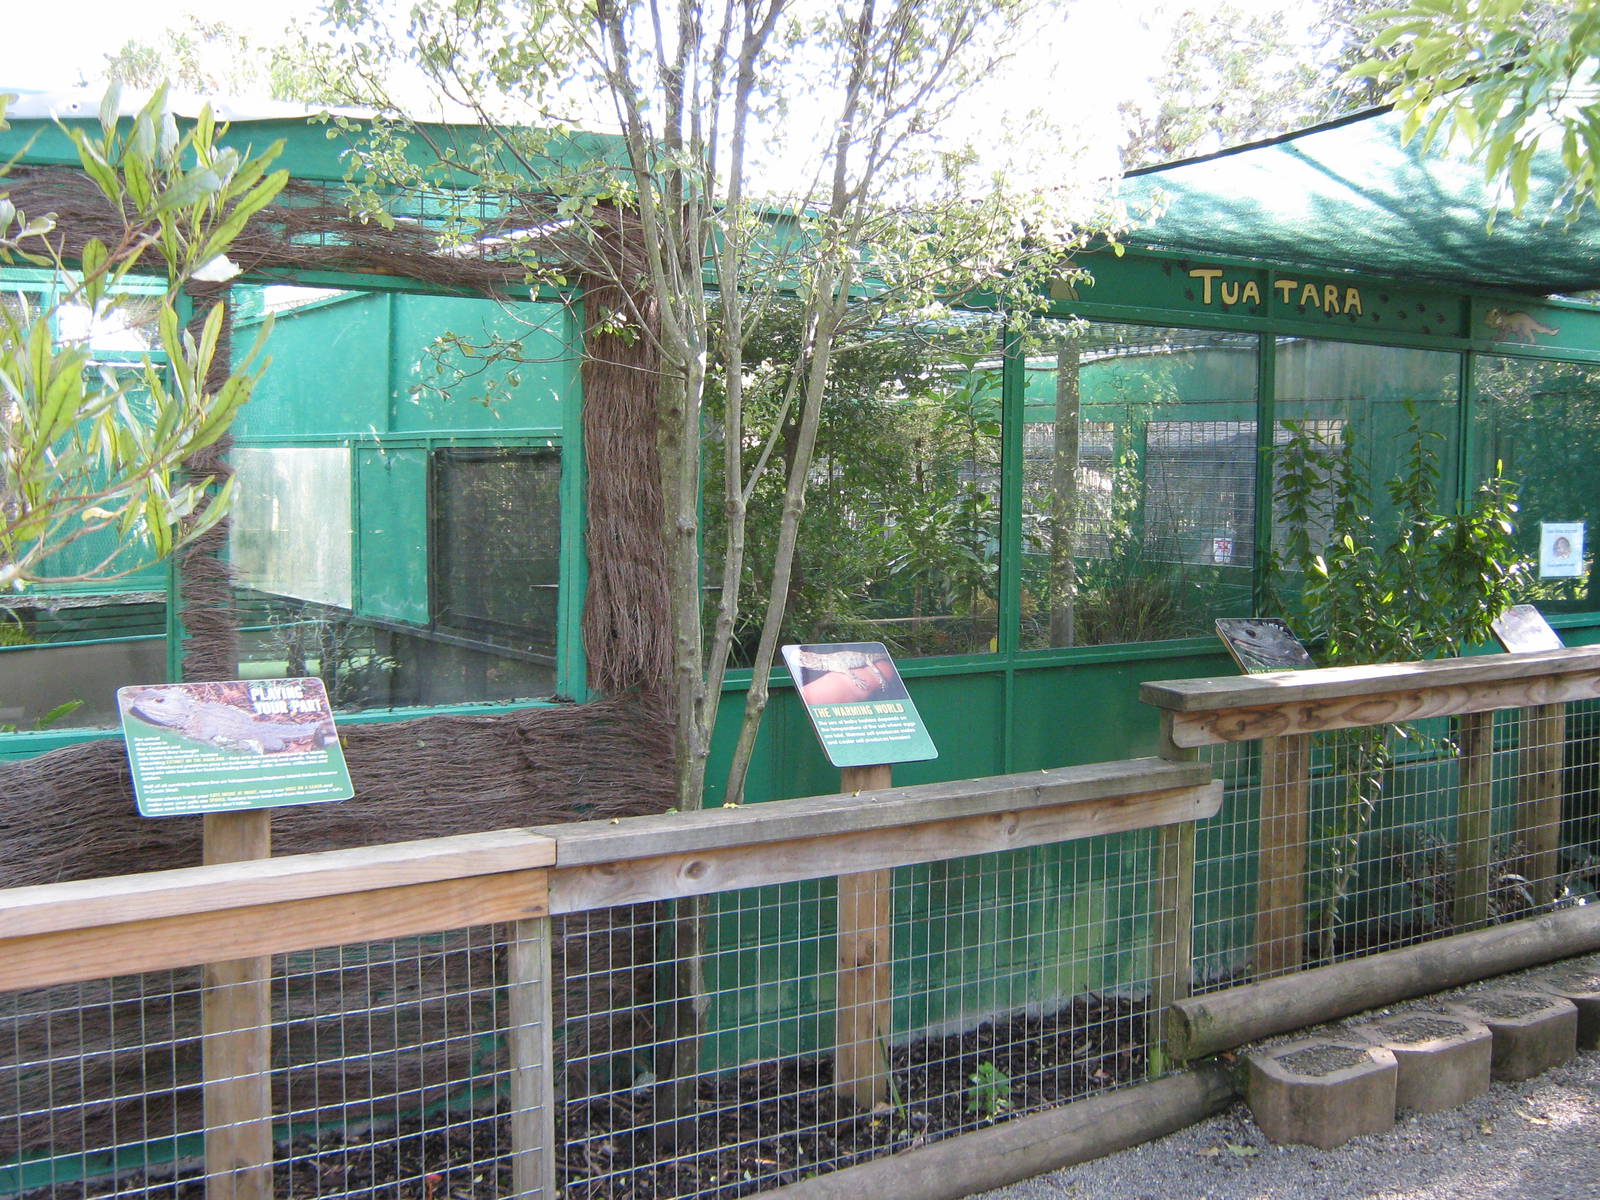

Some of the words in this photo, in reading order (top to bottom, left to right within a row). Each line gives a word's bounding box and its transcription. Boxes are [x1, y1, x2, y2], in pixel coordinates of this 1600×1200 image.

[1189, 269, 1261, 305] TUA
[1274, 279, 1363, 316] TARA
[251, 685, 303, 701] PLAYING
[255, 700, 288, 714] YOUR
[290, 699, 321, 712] PART
[812, 707, 831, 718] THE
[832, 704, 873, 717] WARMING
[874, 703, 905, 714] WORLD
